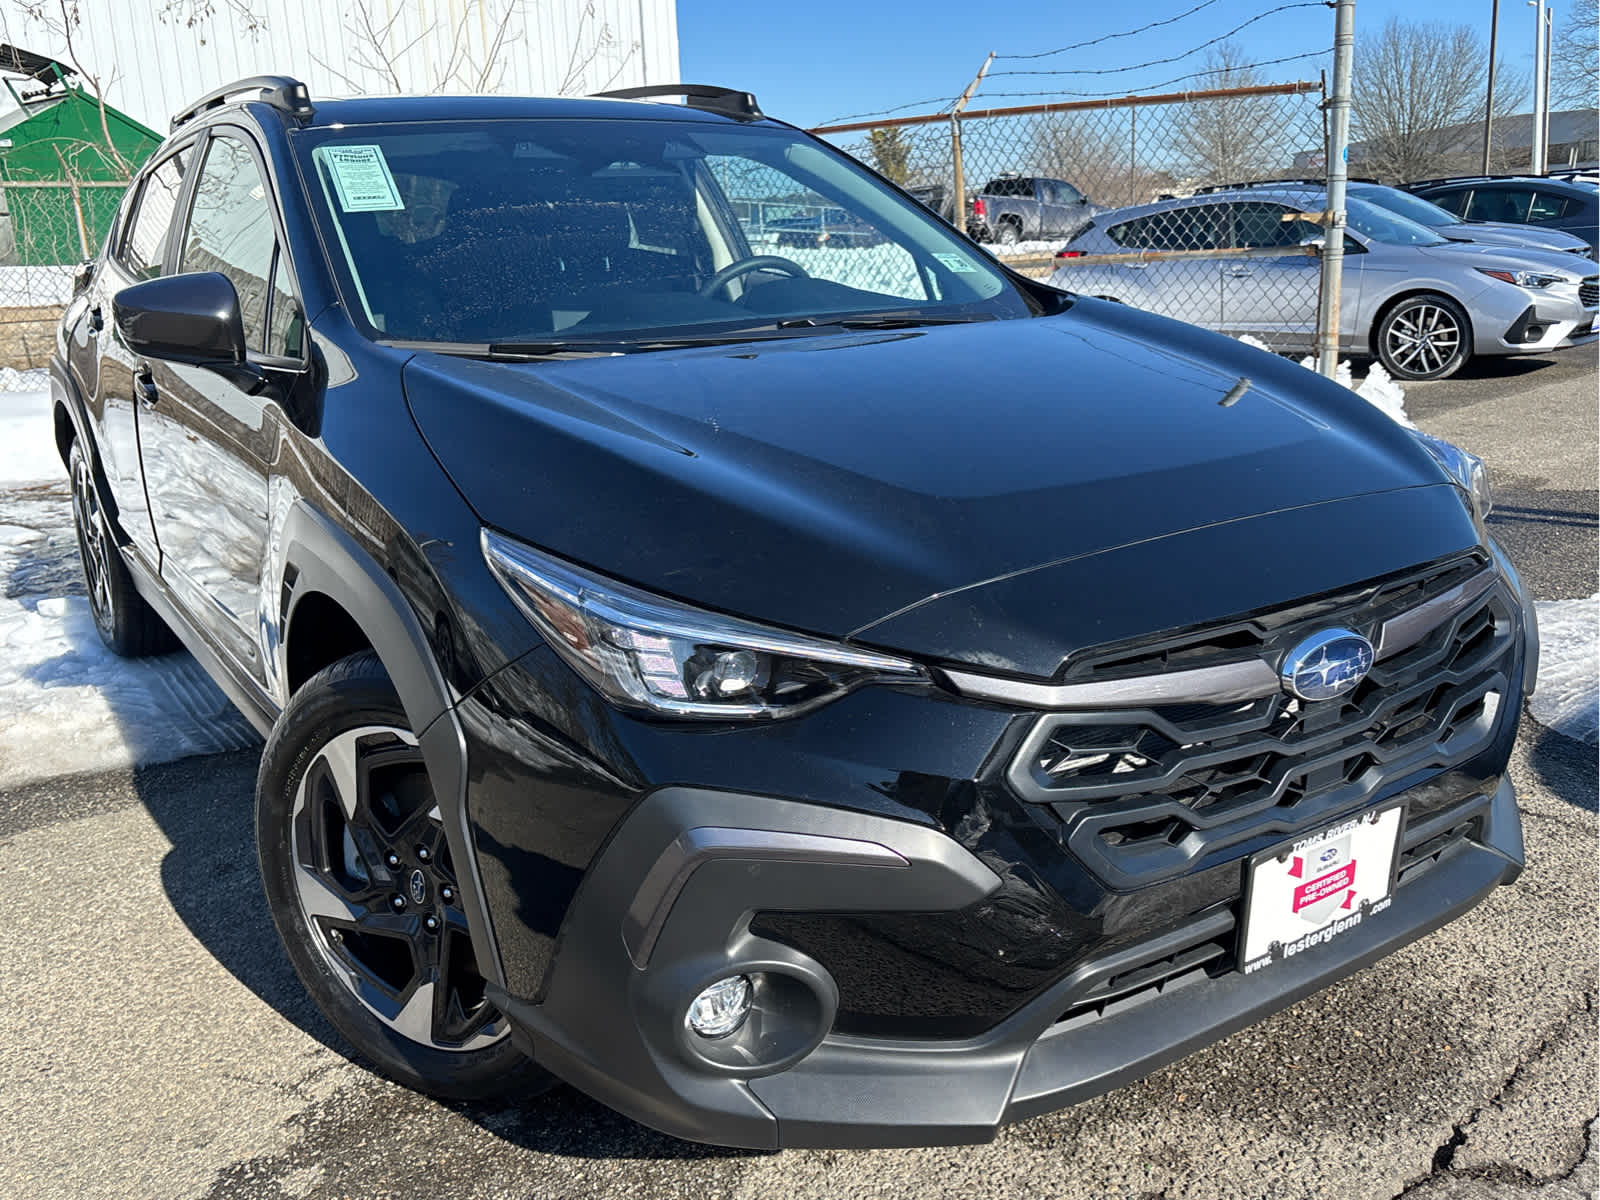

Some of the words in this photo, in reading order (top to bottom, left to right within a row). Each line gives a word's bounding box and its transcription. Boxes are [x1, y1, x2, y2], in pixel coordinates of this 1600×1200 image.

[1292, 833, 1324, 851] TOMS
[1299, 877, 1350, 905] PRE-OWNED
[1304, 870, 1347, 894] CERTIFIED
[1283, 912, 1362, 958] lesterglenn
